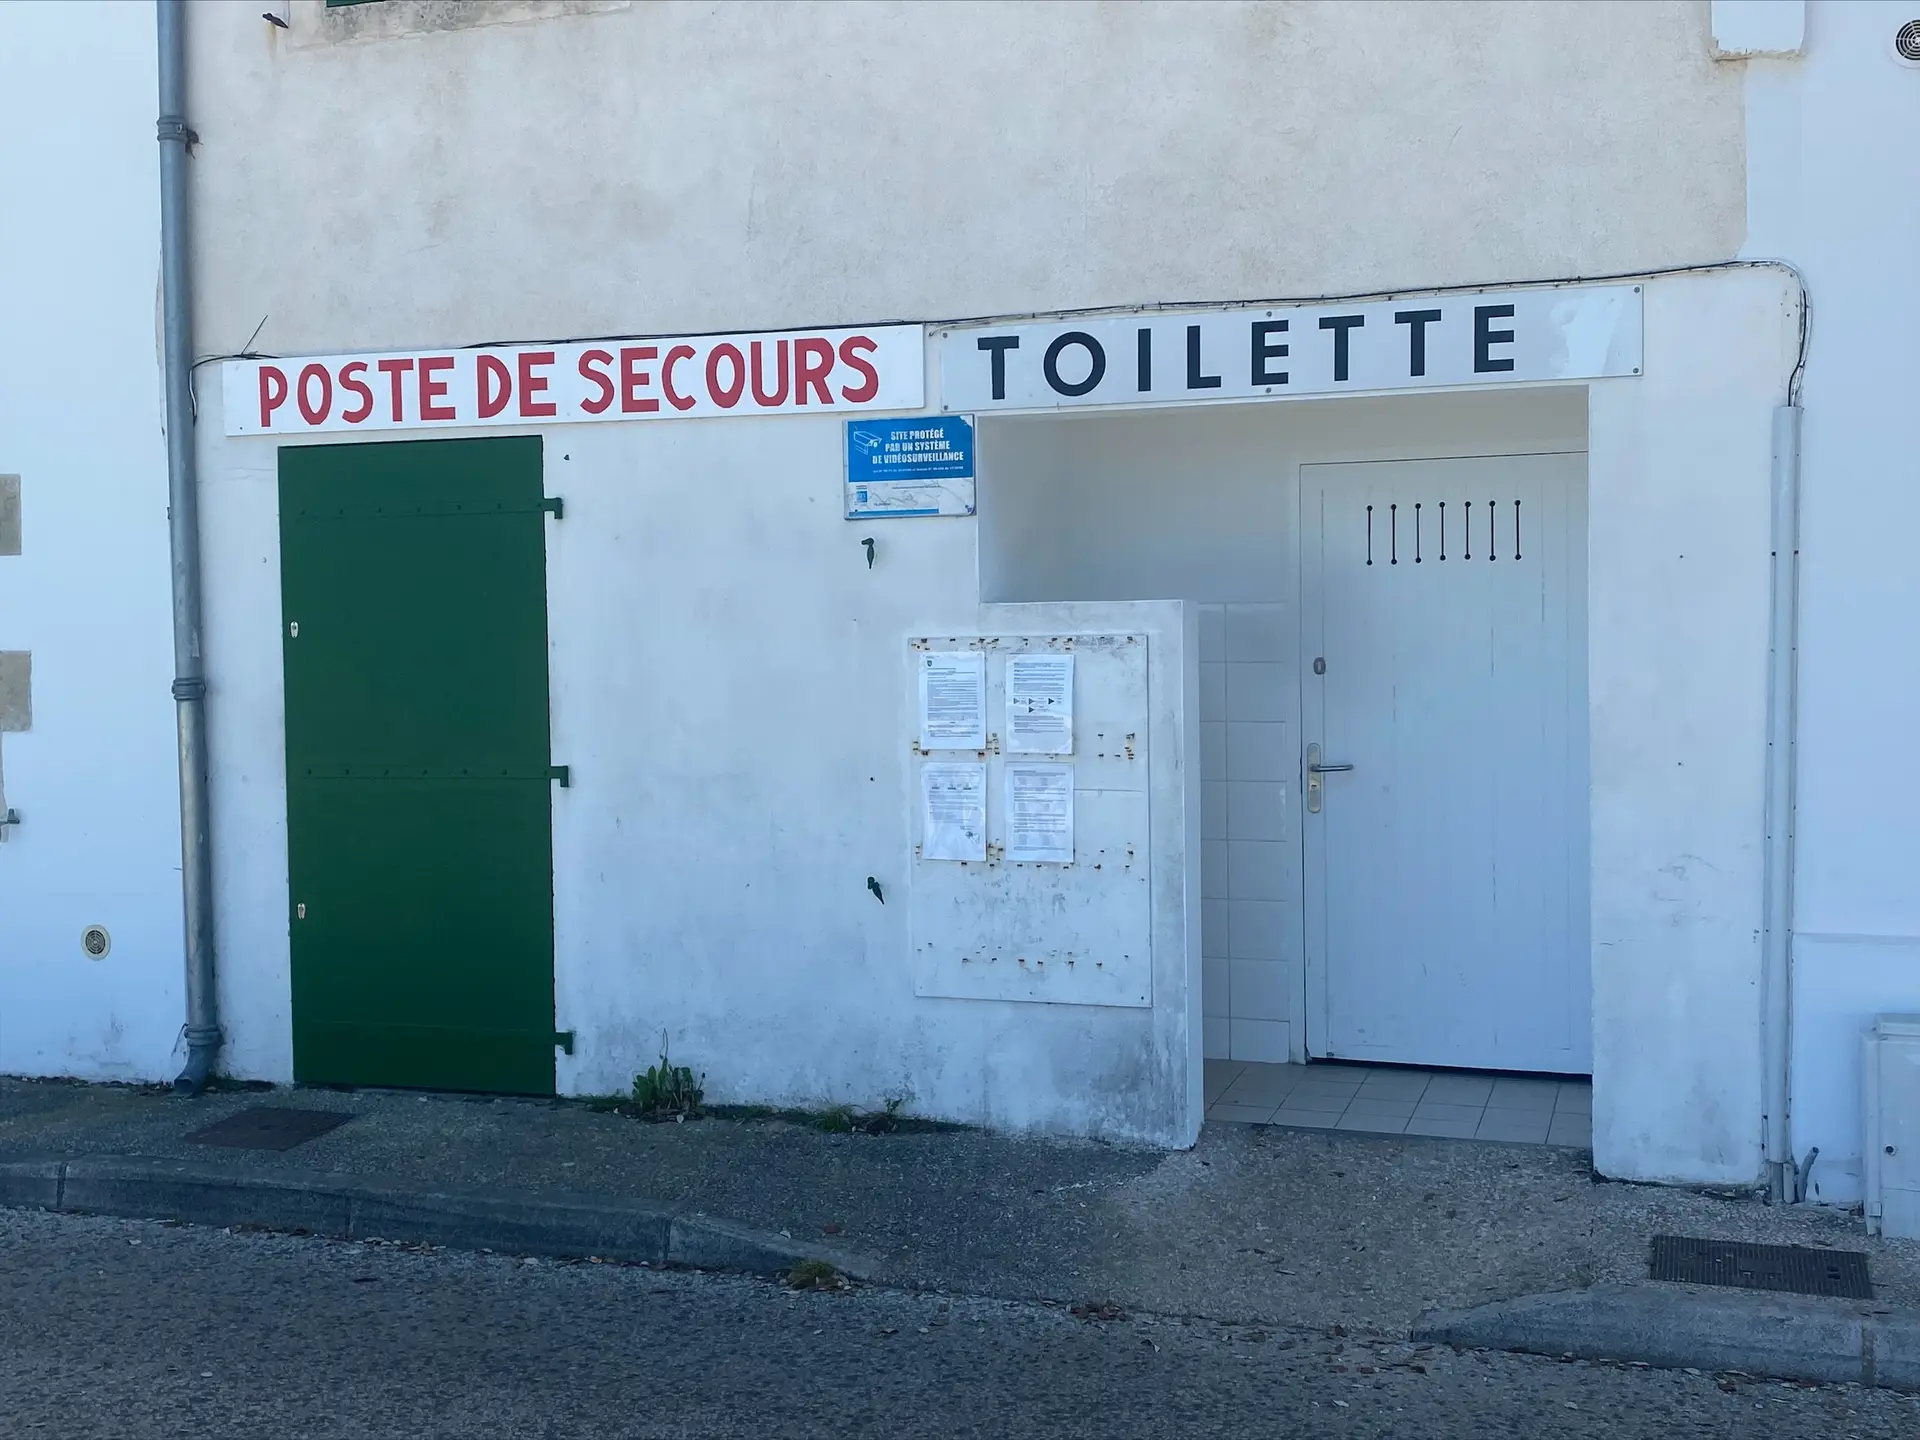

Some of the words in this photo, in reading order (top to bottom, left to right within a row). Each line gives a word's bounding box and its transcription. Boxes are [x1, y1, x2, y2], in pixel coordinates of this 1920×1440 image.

[977, 304, 1515, 400] TOILETTE
[259, 356, 456, 428] POSTE
[477, 351, 556, 419] DE
[578, 335, 879, 414] SECOURS
[891, 430, 908, 440] SITE
[909, 428, 944, 439] PROTÉGÉ
[885, 443, 900, 452] PAR
[902, 442, 913, 451] UN
[914, 440, 950, 451] SYSTÈME
[872, 456, 882, 464] DE
[883, 451, 964, 463] VIDÉOSURVEILLANCE
